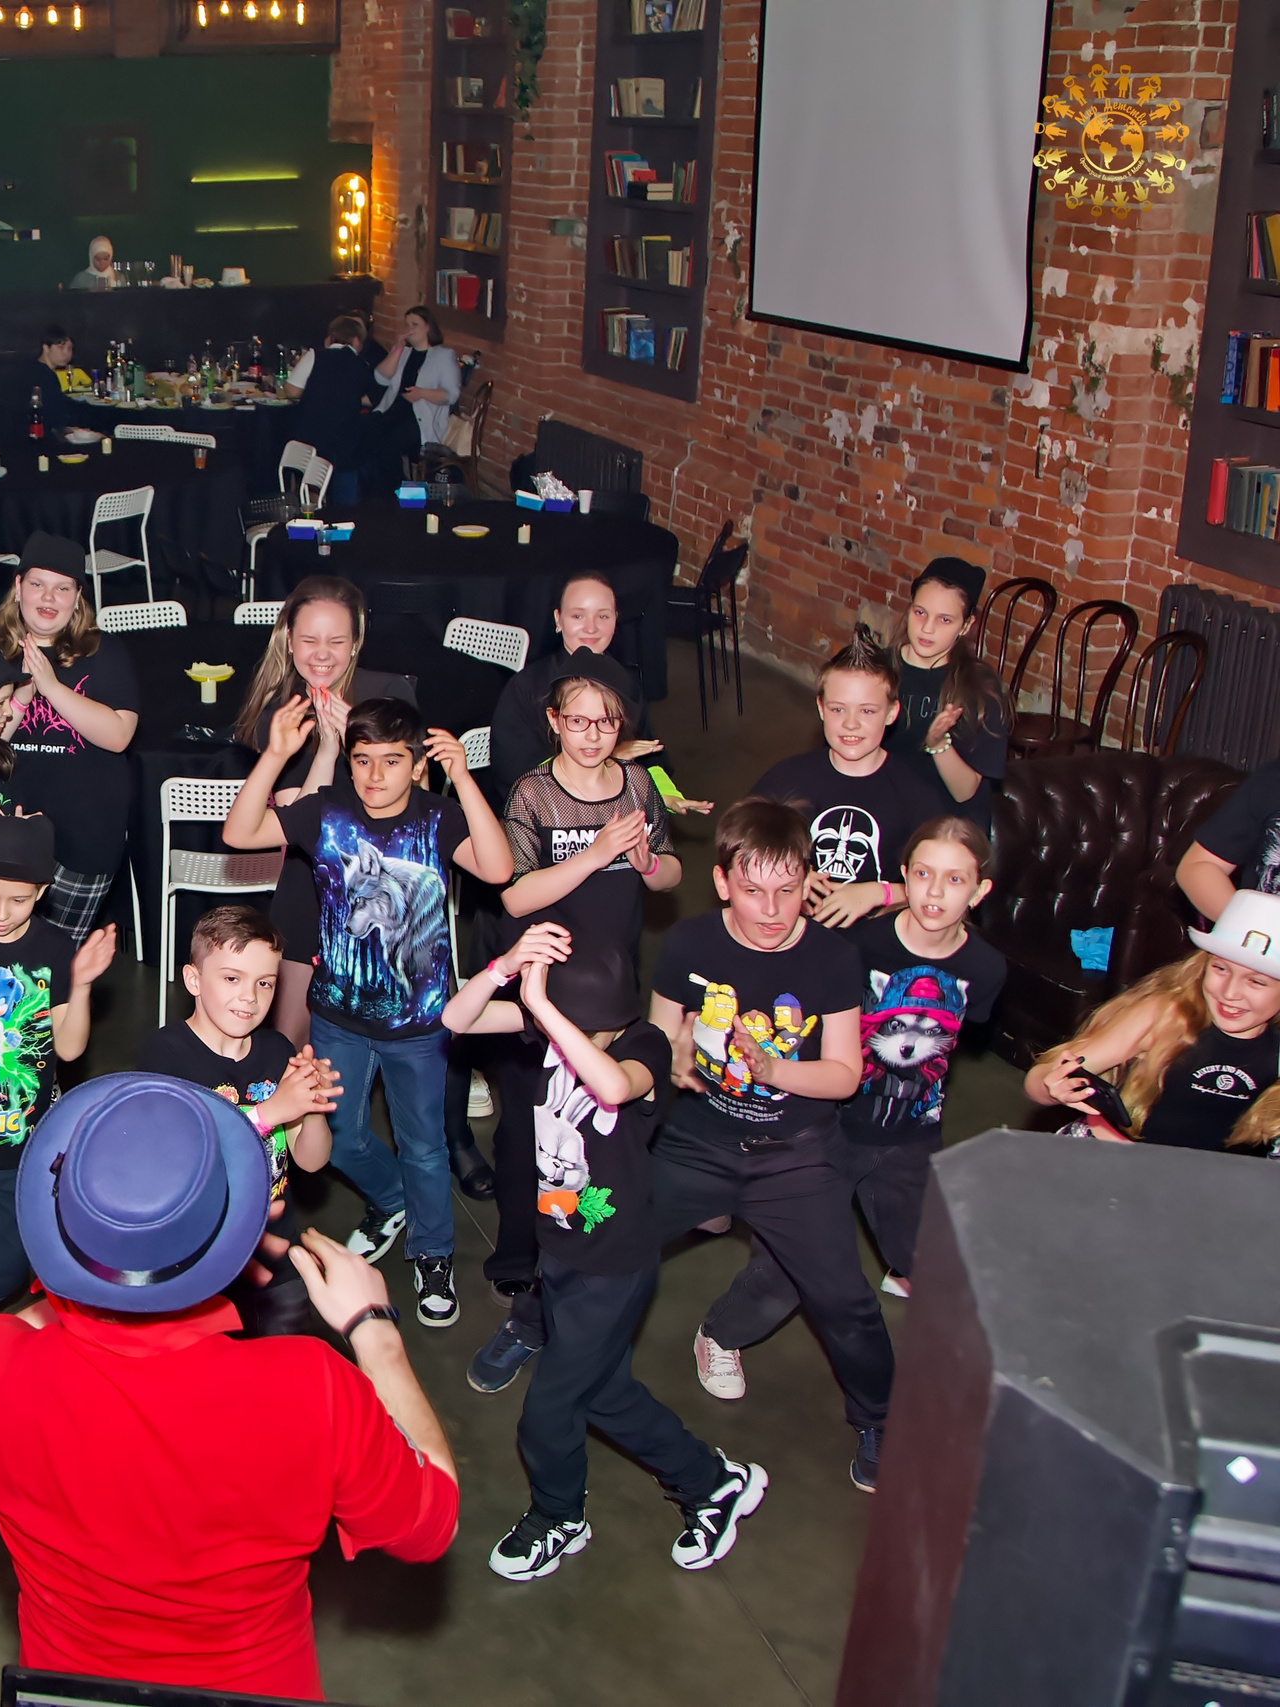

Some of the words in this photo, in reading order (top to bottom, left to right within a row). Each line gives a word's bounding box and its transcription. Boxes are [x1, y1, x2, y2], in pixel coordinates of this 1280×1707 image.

[10, 742, 38, 752] RASH
[40, 744, 66, 754] FONT
[728, 1110, 744, 1119] THE
